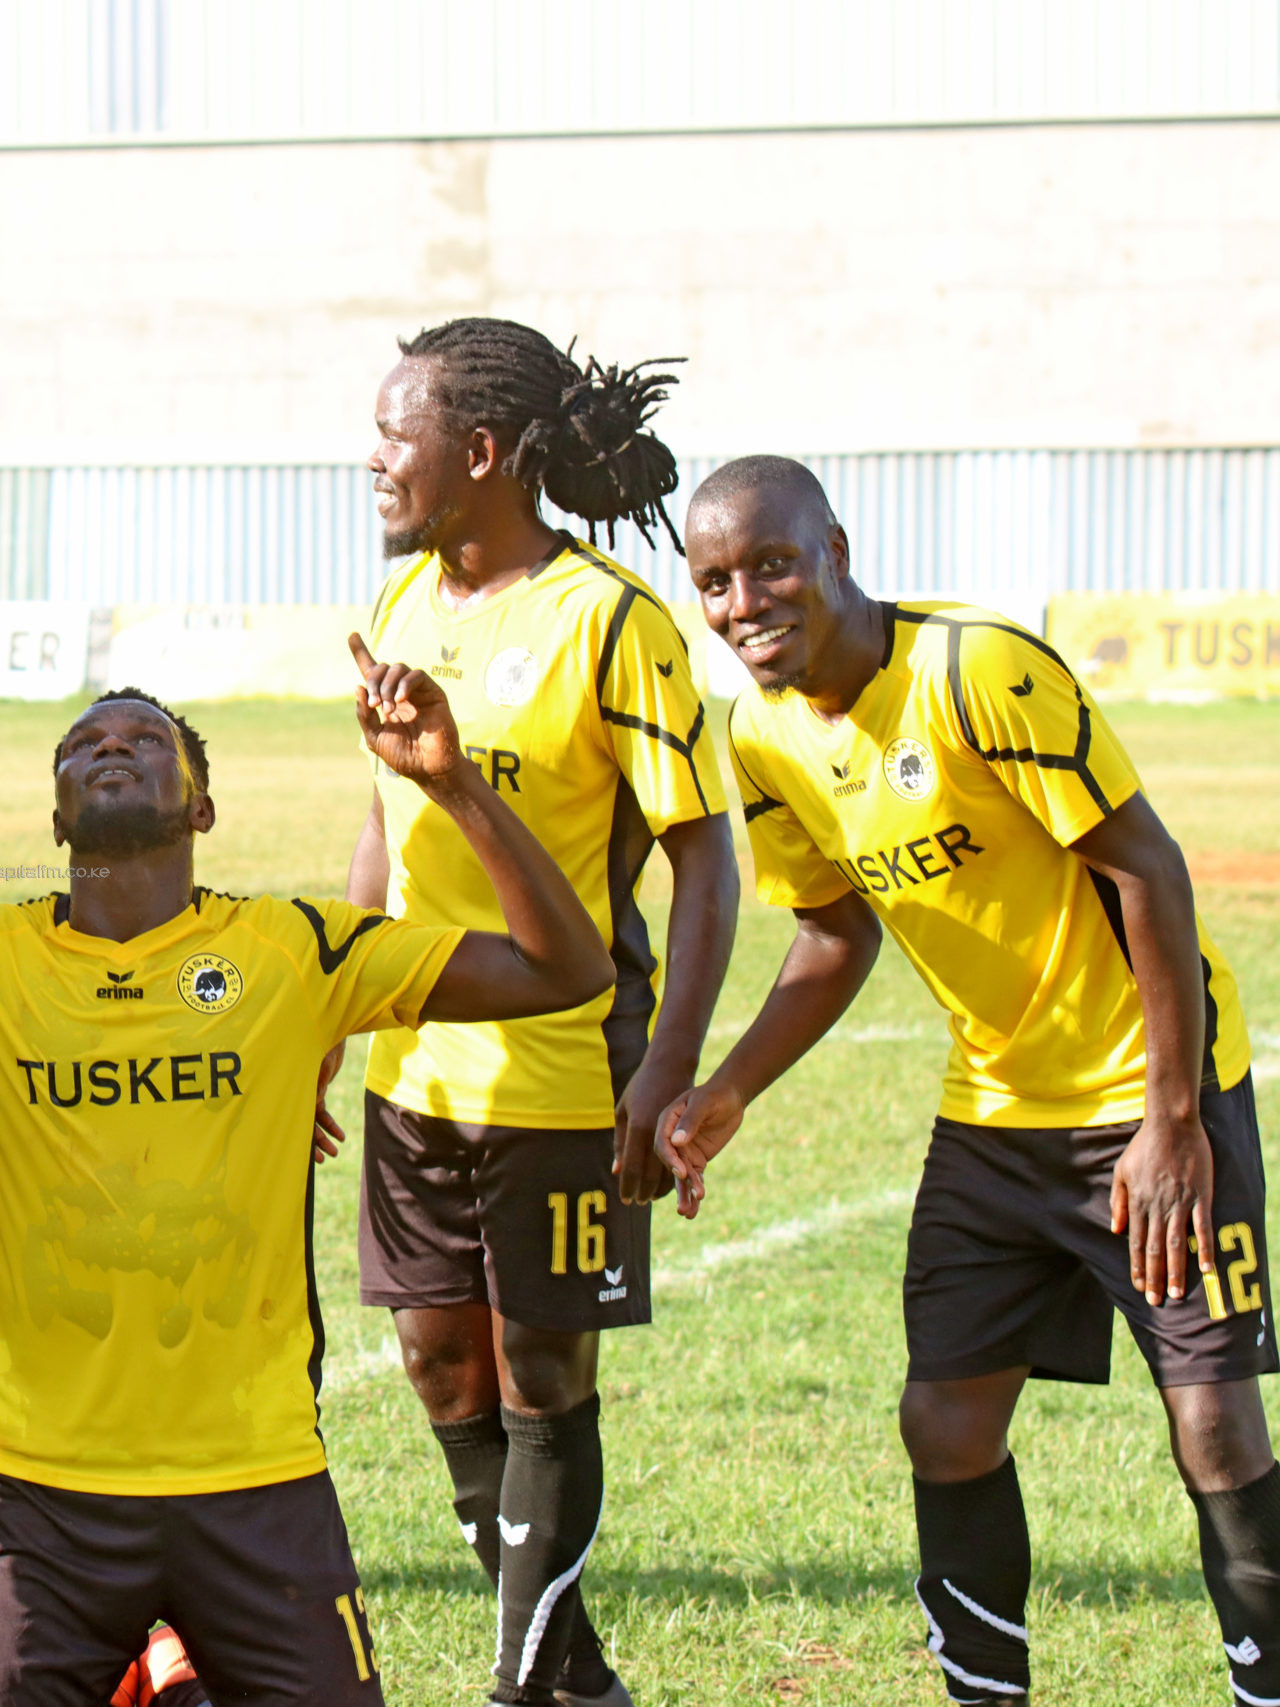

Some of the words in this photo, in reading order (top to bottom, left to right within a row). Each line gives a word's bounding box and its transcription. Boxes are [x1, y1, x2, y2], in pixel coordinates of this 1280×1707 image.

[829, 824, 985, 894] USKER
[96, 985, 144, 999] erima
[182, 958, 235, 983] TUSKER
[16, 1050, 243, 1108] TUSKER
[548, 1189, 607, 1275] 16
[598, 1286, 627, 1302] erima
[1188, 1221, 1262, 1320] 12
[335, 1586, 380, 1682] 1
